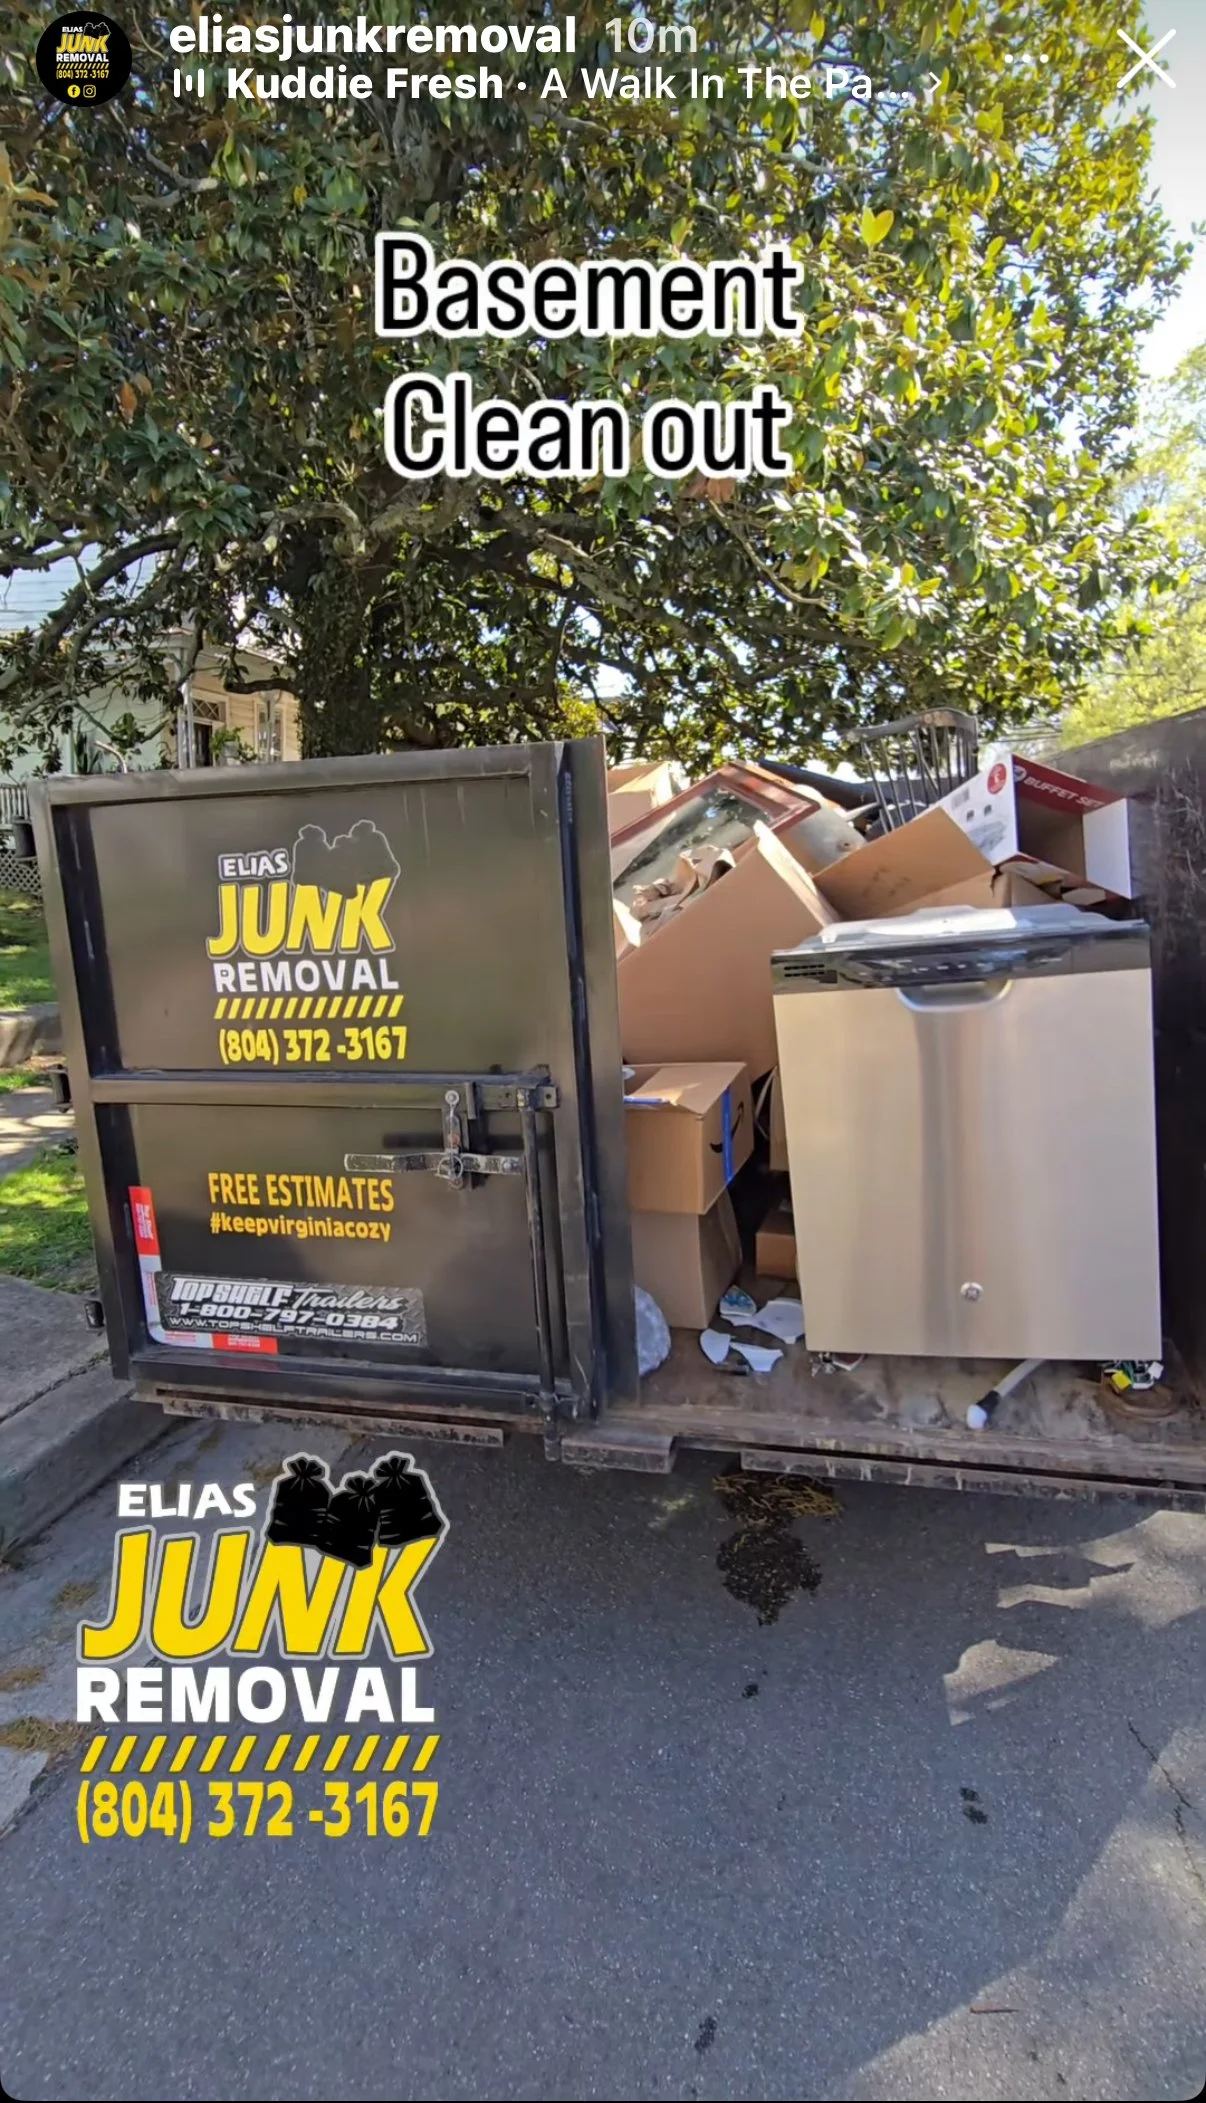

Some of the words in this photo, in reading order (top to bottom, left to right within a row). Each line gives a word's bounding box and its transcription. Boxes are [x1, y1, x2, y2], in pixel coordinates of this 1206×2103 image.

[1023, 776, 1079, 800] BUFFET
[222, 852, 289, 878] ELIAS
[207, 877, 393, 955] JUNK
[213, 958, 400, 993] REMOVAL
[219, 1028, 279, 1065] (804)
[283, 1028, 332, 1062] 372
[336, 1026, 408, 1061] -3167
[208, 1172, 261, 1206] FREE
[265, 1172, 395, 1212] ESTIMATES
[209, 1212, 391, 1242] #keepvirginiacozy
[292, 1287, 404, 1310] Trailers
[169, 1317, 418, 1343] WWW.TOPSHELFTRAILERS.COM
[179, 1302, 399, 1330] 1-800-797-0384
